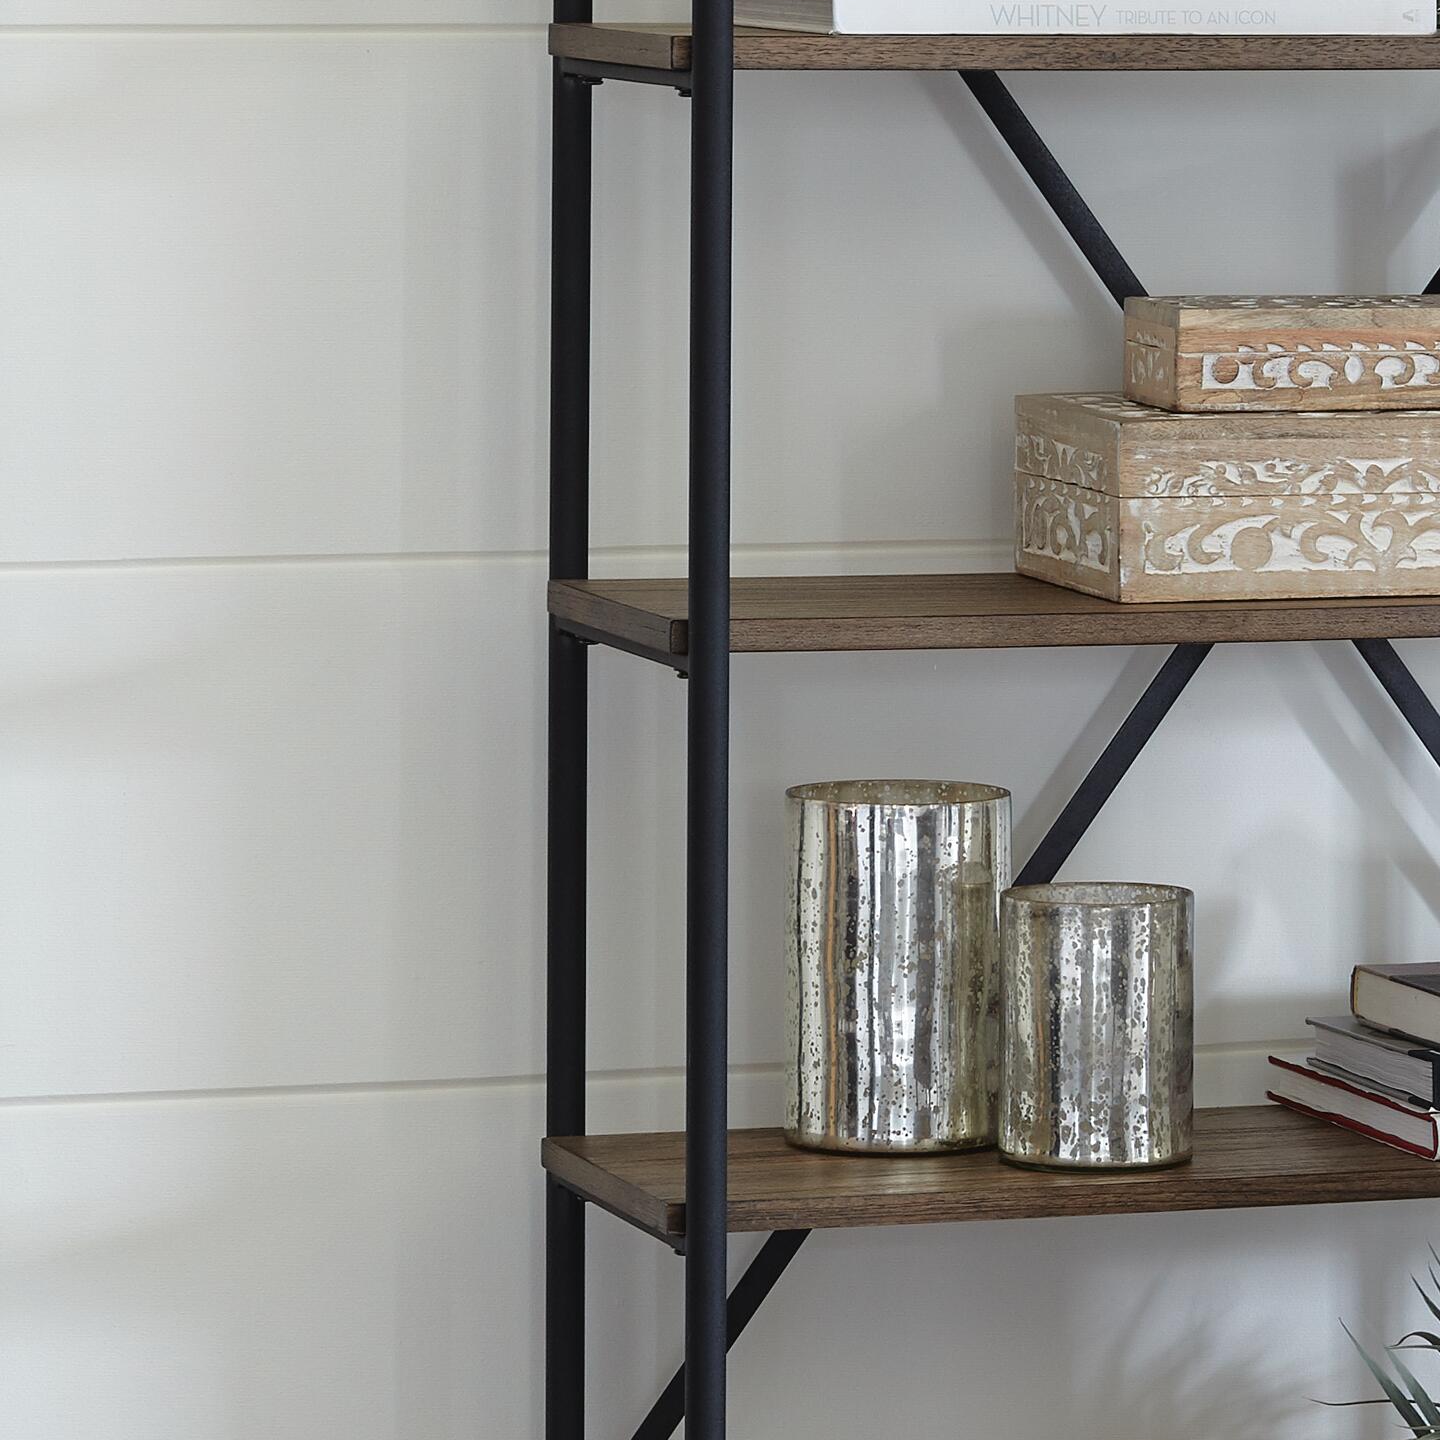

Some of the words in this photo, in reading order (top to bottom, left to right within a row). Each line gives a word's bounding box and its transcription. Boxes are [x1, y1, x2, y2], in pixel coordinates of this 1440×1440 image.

[990, 4, 1108, 28] WHITNEY
[1115, 10, 1177, 25] TRIBUTE
[1181, 10, 1203, 25] TO
[1207, 10, 1229, 25] AN
[1235, 10, 1277, 25] ICON
